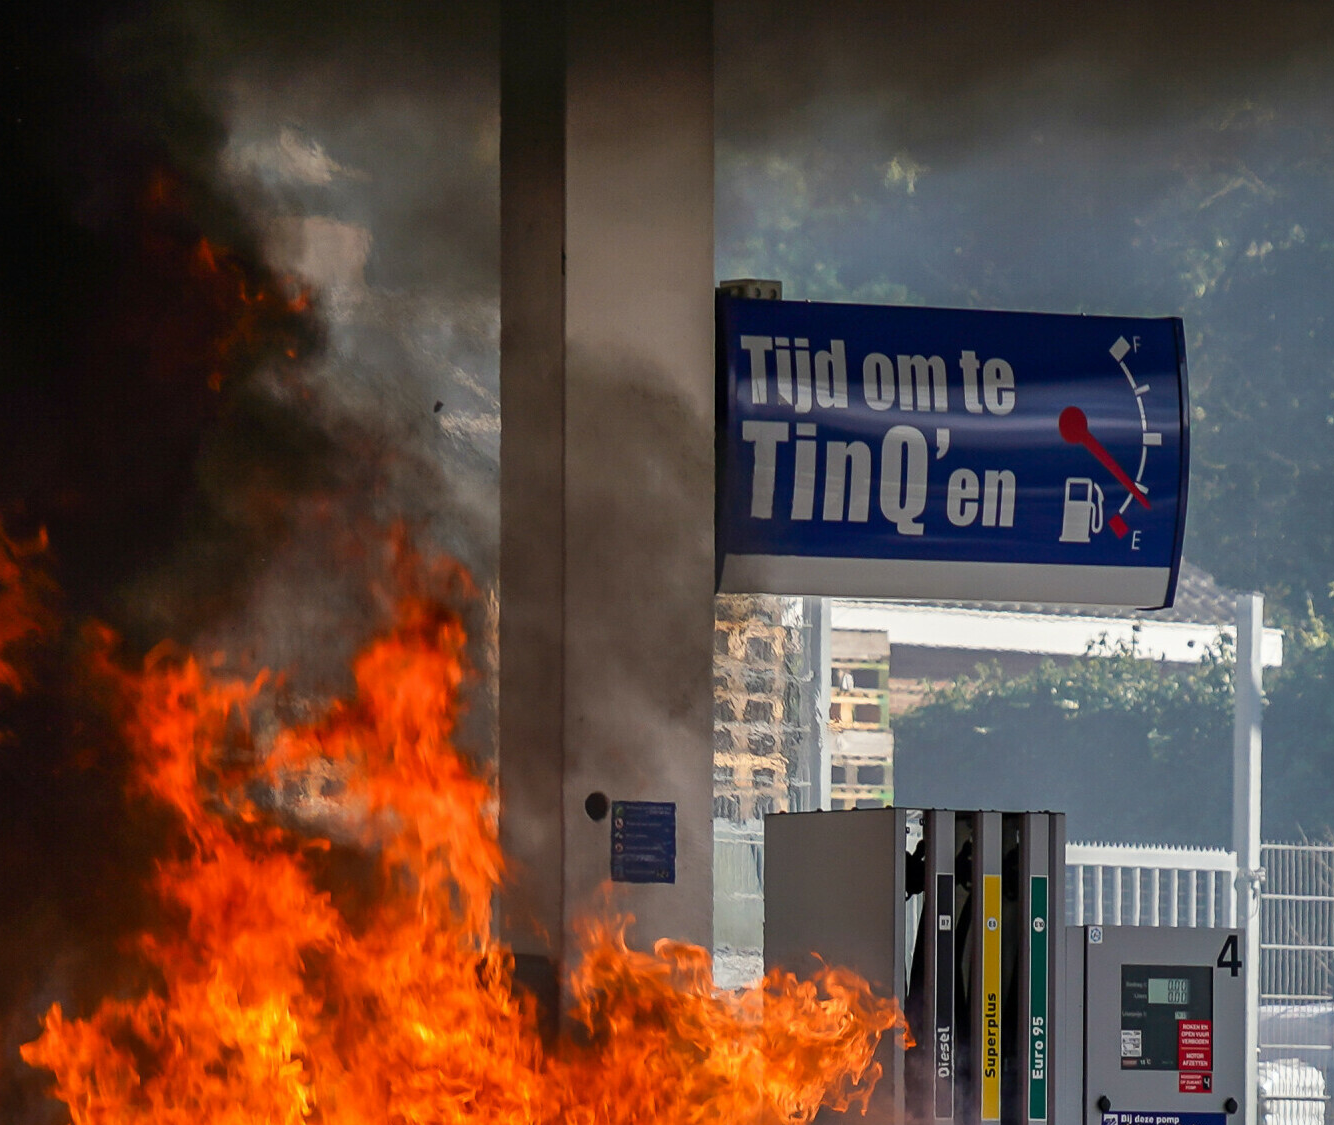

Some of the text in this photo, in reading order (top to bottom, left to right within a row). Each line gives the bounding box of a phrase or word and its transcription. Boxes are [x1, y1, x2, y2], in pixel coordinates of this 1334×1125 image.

[740, 335, 1016, 416] Tijd om te
[1131, 530, 1142, 550] E
[1217, 934, 1242, 977] 4
[937, 1025, 950, 1079] Diesel
[985, 992, 999, 1078] Superplus
[1032, 1016, 1044, 1080] Euro 95
[1121, 1114, 1180, 1125] Bij deze pomp
